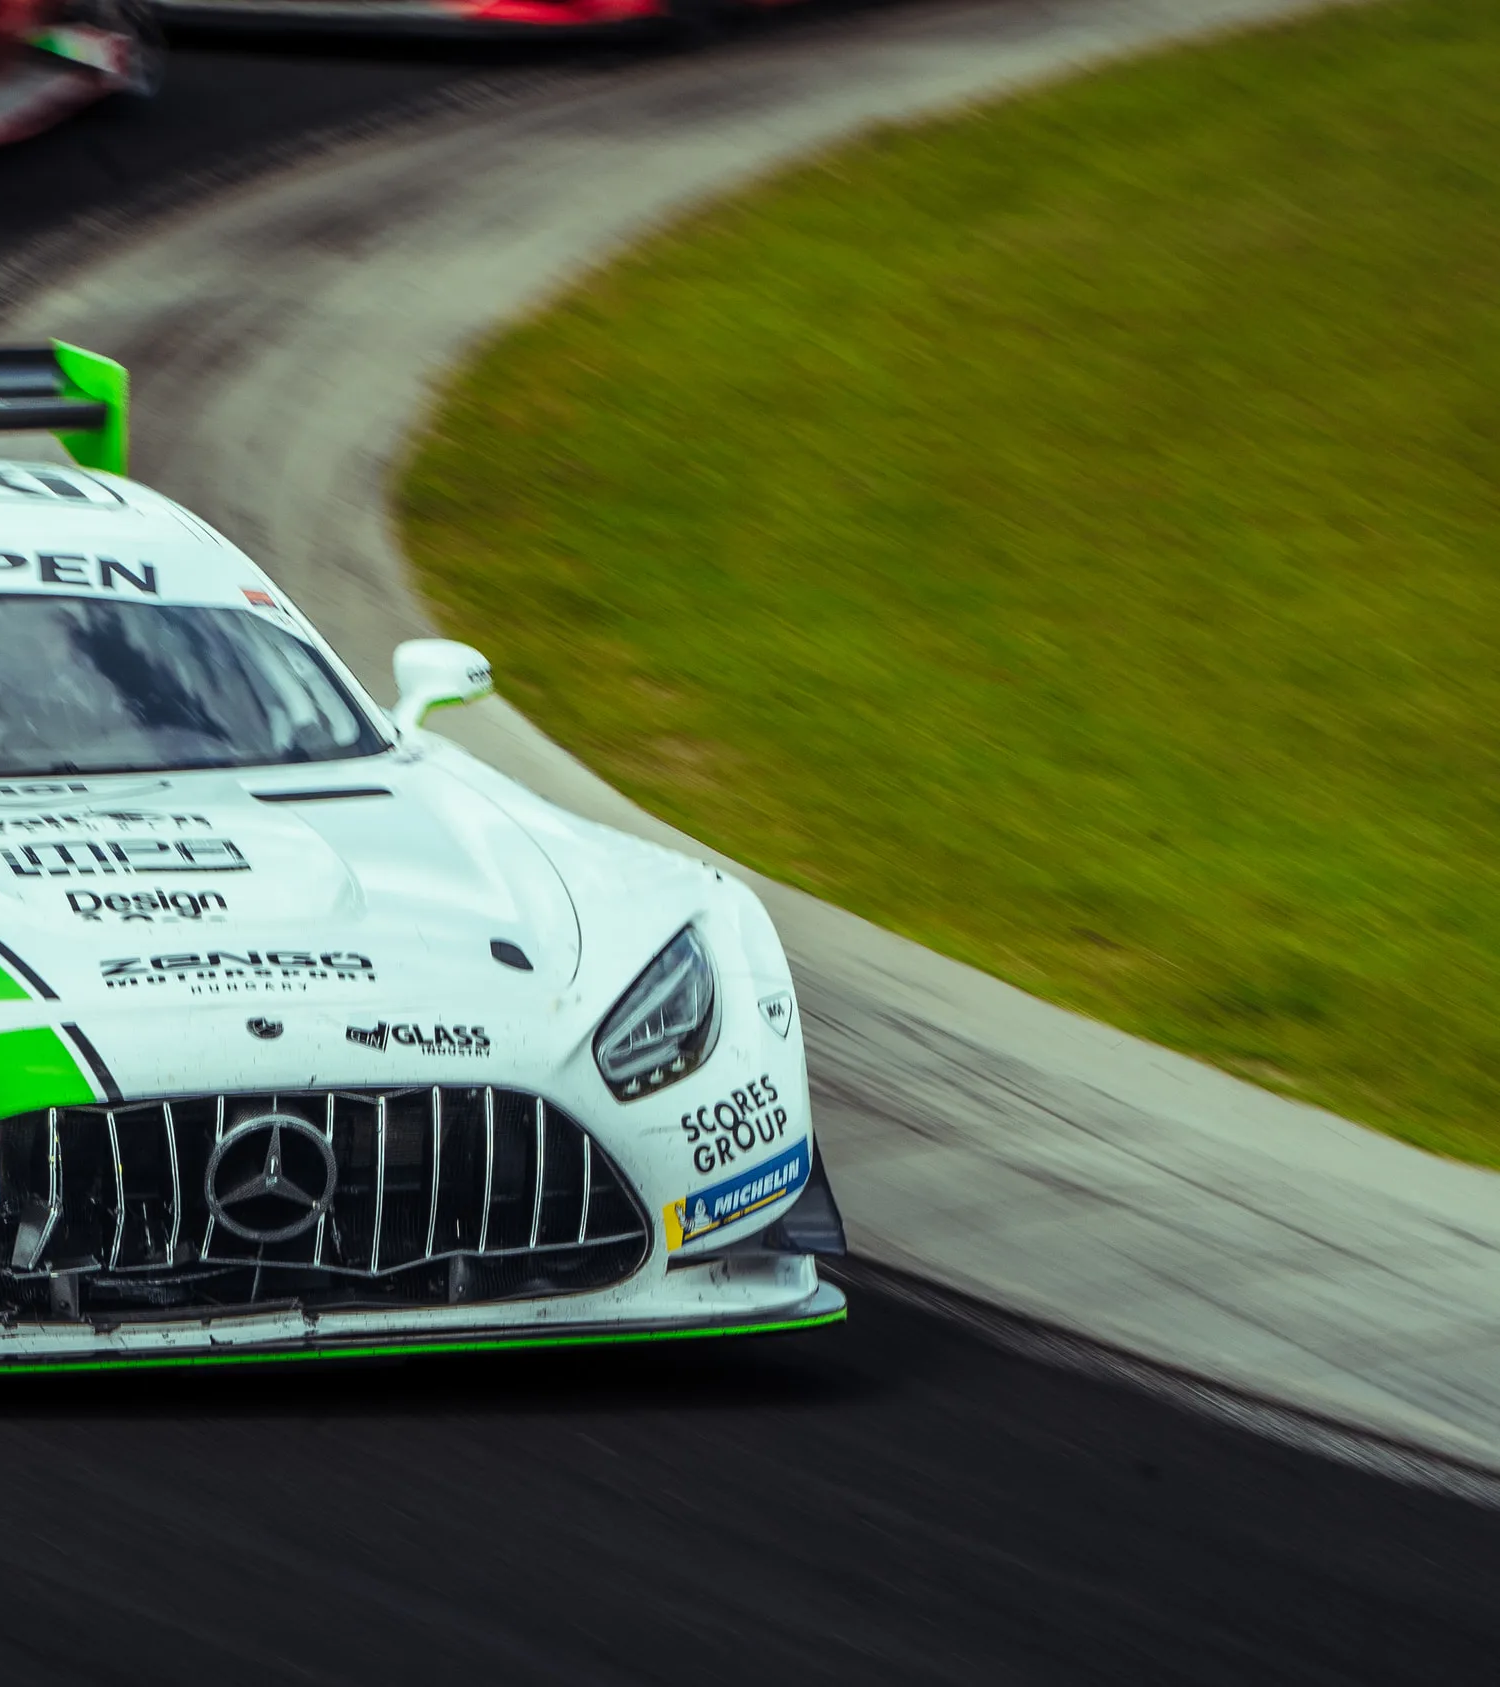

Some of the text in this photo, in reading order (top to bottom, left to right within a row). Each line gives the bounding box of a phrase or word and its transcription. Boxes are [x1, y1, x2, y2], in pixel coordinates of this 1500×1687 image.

[65, 887, 229, 920] Design
[391, 1023, 490, 1046] GLASS
[681, 1073, 779, 1145] SCORES
[693, 1107, 788, 1174] GROUP
[713, 1156, 800, 1218] MICHELIN
